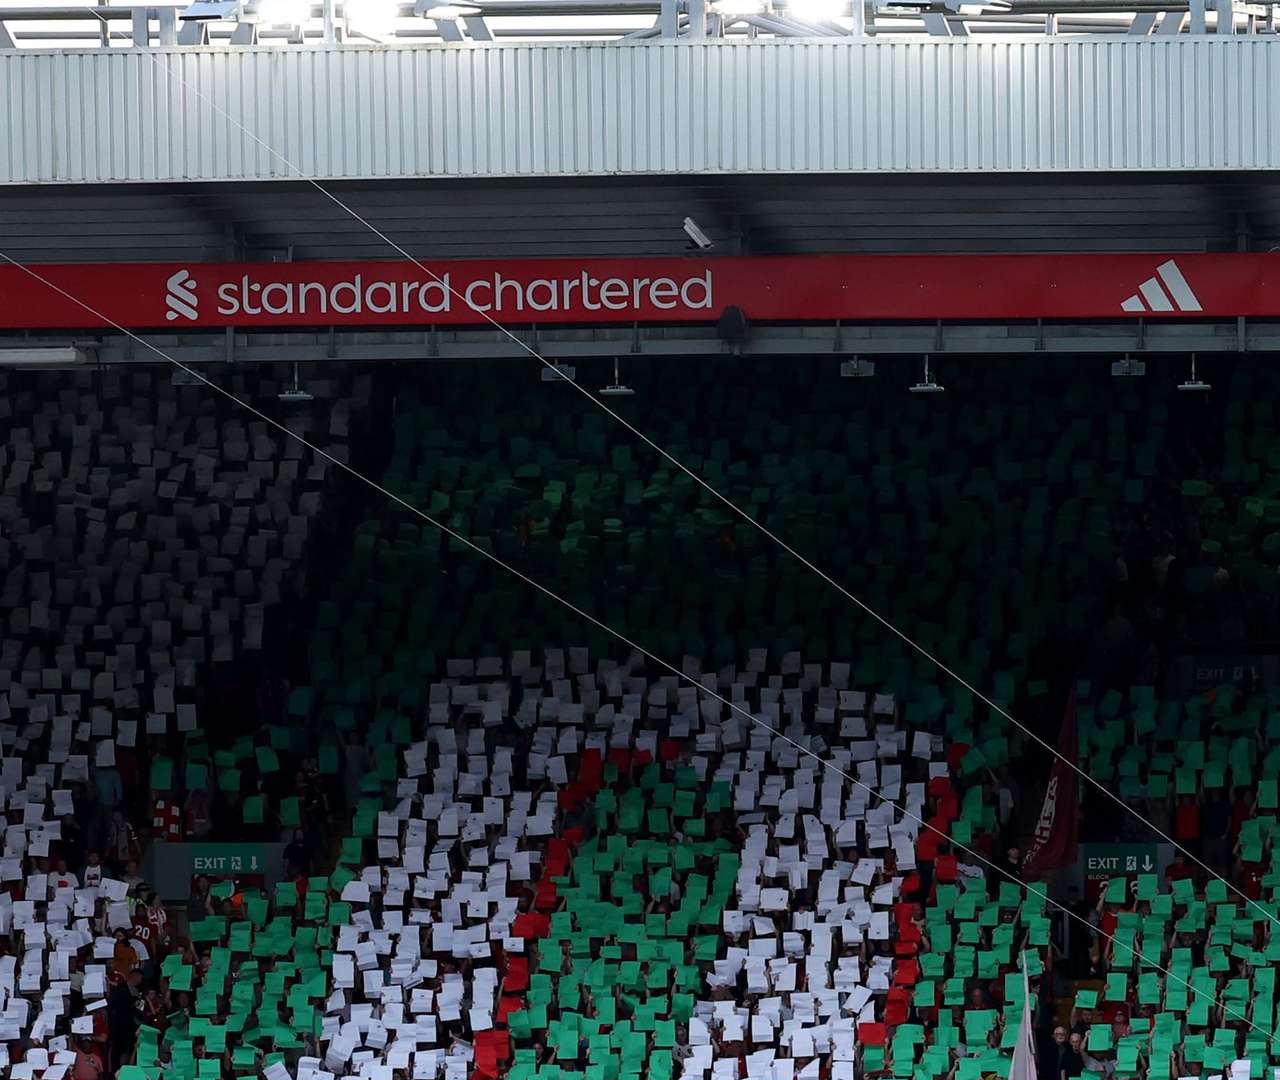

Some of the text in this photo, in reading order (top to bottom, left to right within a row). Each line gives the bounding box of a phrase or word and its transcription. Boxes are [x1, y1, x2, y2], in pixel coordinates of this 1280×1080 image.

[217, 268, 713, 316] standard chartered
[193, 856, 226, 870] EXIT
[1087, 857, 1119, 870] EXIT
[135, 925, 150, 938] 20
